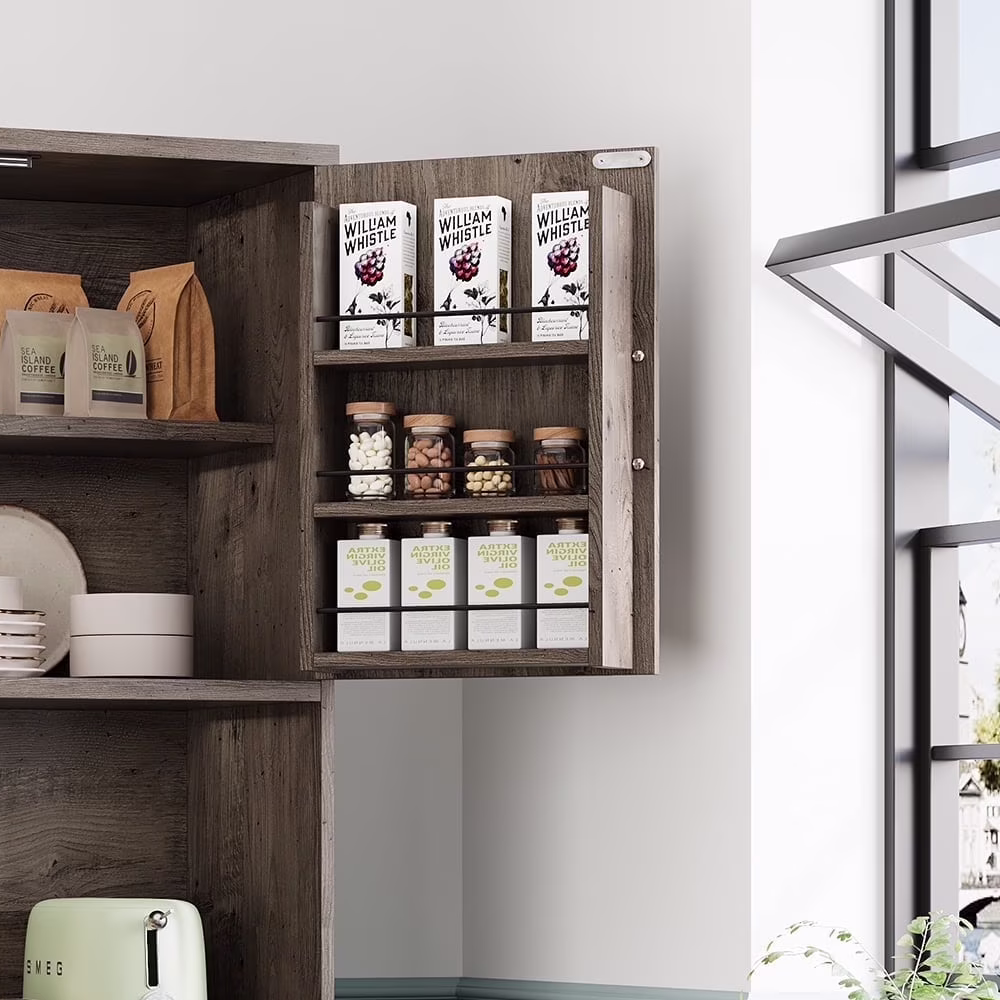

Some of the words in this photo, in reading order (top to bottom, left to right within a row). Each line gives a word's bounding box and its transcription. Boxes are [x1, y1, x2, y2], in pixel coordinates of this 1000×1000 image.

[439, 210, 492, 234] WILLIAM
[537, 205, 589, 228] WILLIAM
[344, 216, 397, 238] WILLIAM
[537, 219, 589, 246] WHISTLE
[344, 228, 397, 256] WHISTLE
[439, 223, 492, 252] WHISTLE
[21, 347, 37, 356] SEA
[91, 344, 106, 353] SEA
[21, 356, 52, 365] ISLAND
[92, 353, 119, 363] ISLAND
[21, 364, 56, 374] COFFEE
[93, 362, 123, 372] COFFEE
[26, 960, 64, 976] SMEG
